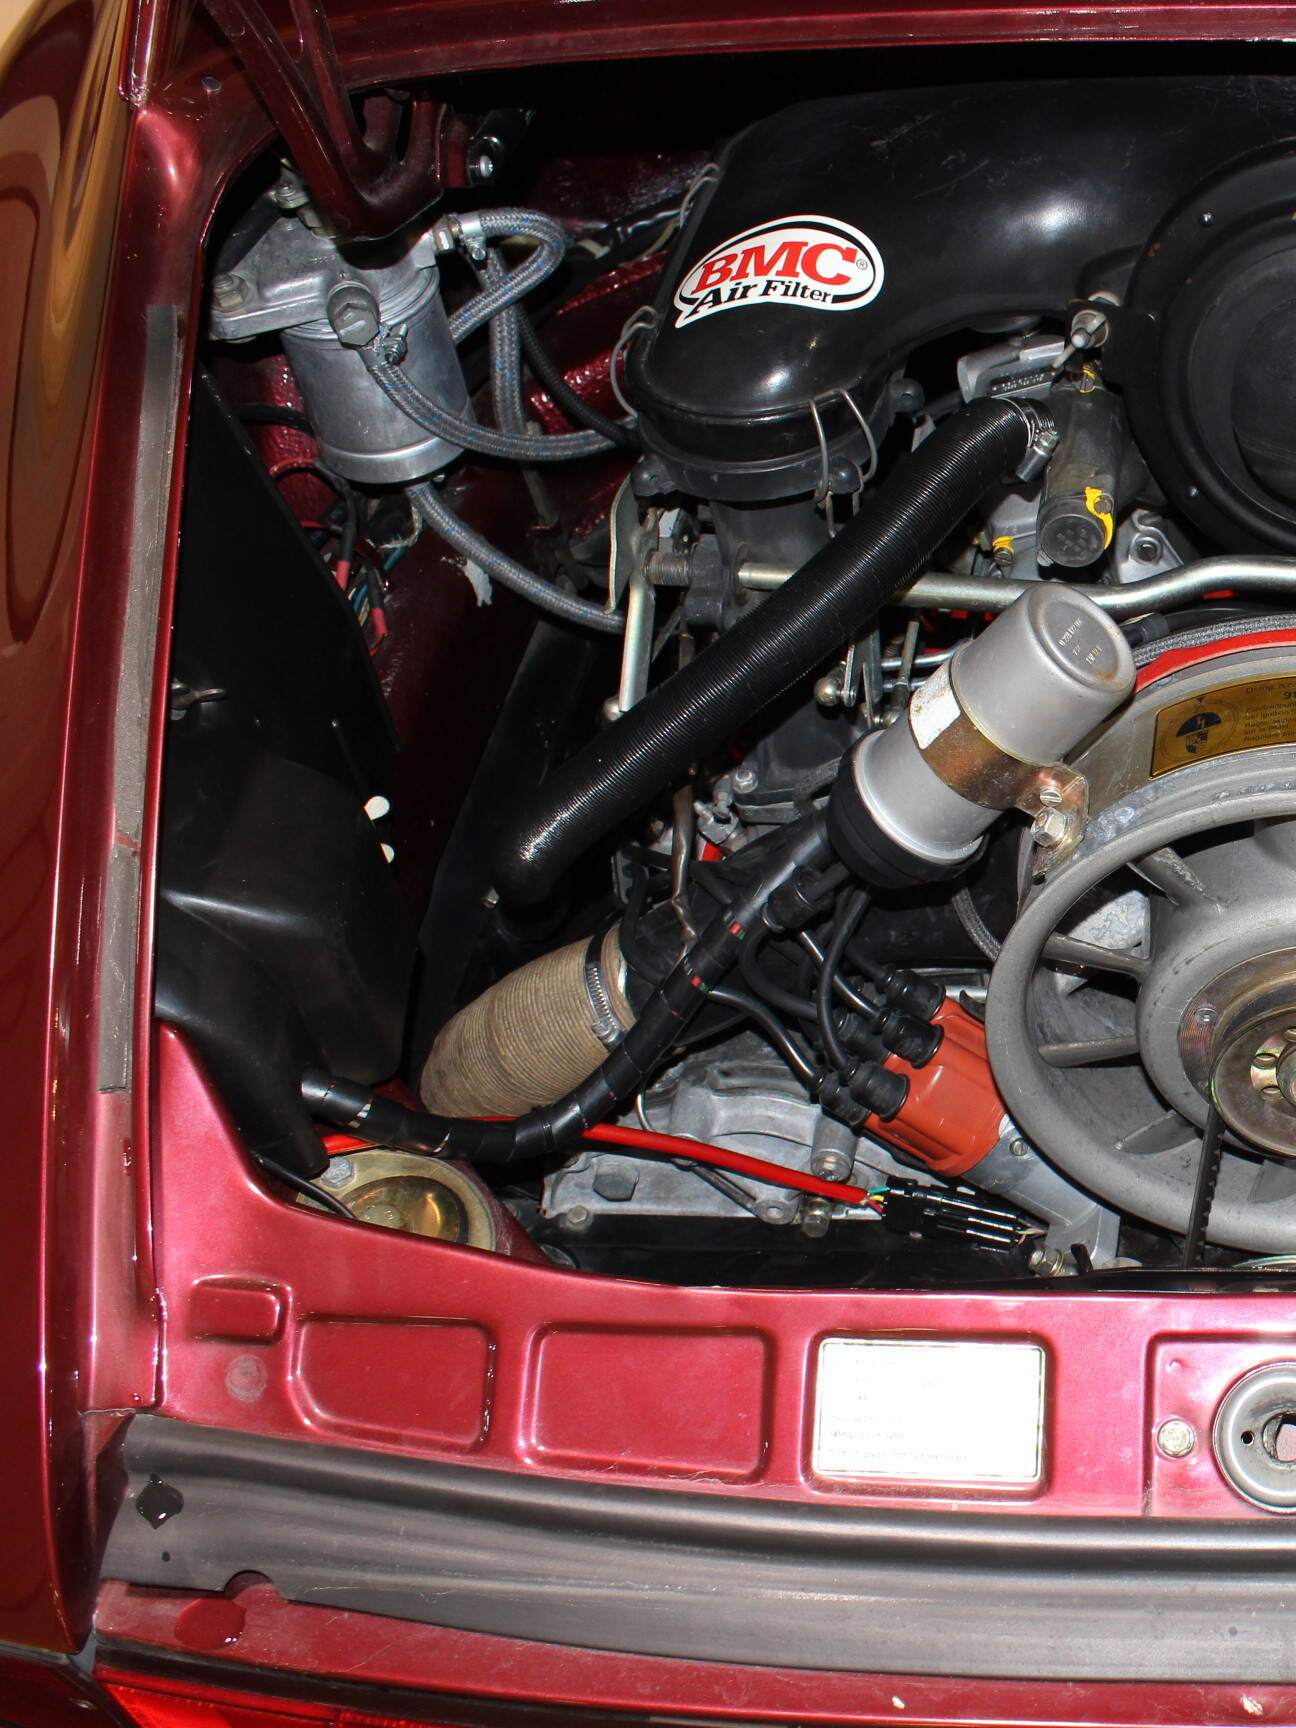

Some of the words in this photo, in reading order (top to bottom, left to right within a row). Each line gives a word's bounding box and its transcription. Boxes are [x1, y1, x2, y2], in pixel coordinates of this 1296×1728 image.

[690, 241, 858, 295] BMC
[685, 281, 757, 319] Air
[759, 280, 832, 303] Filter
